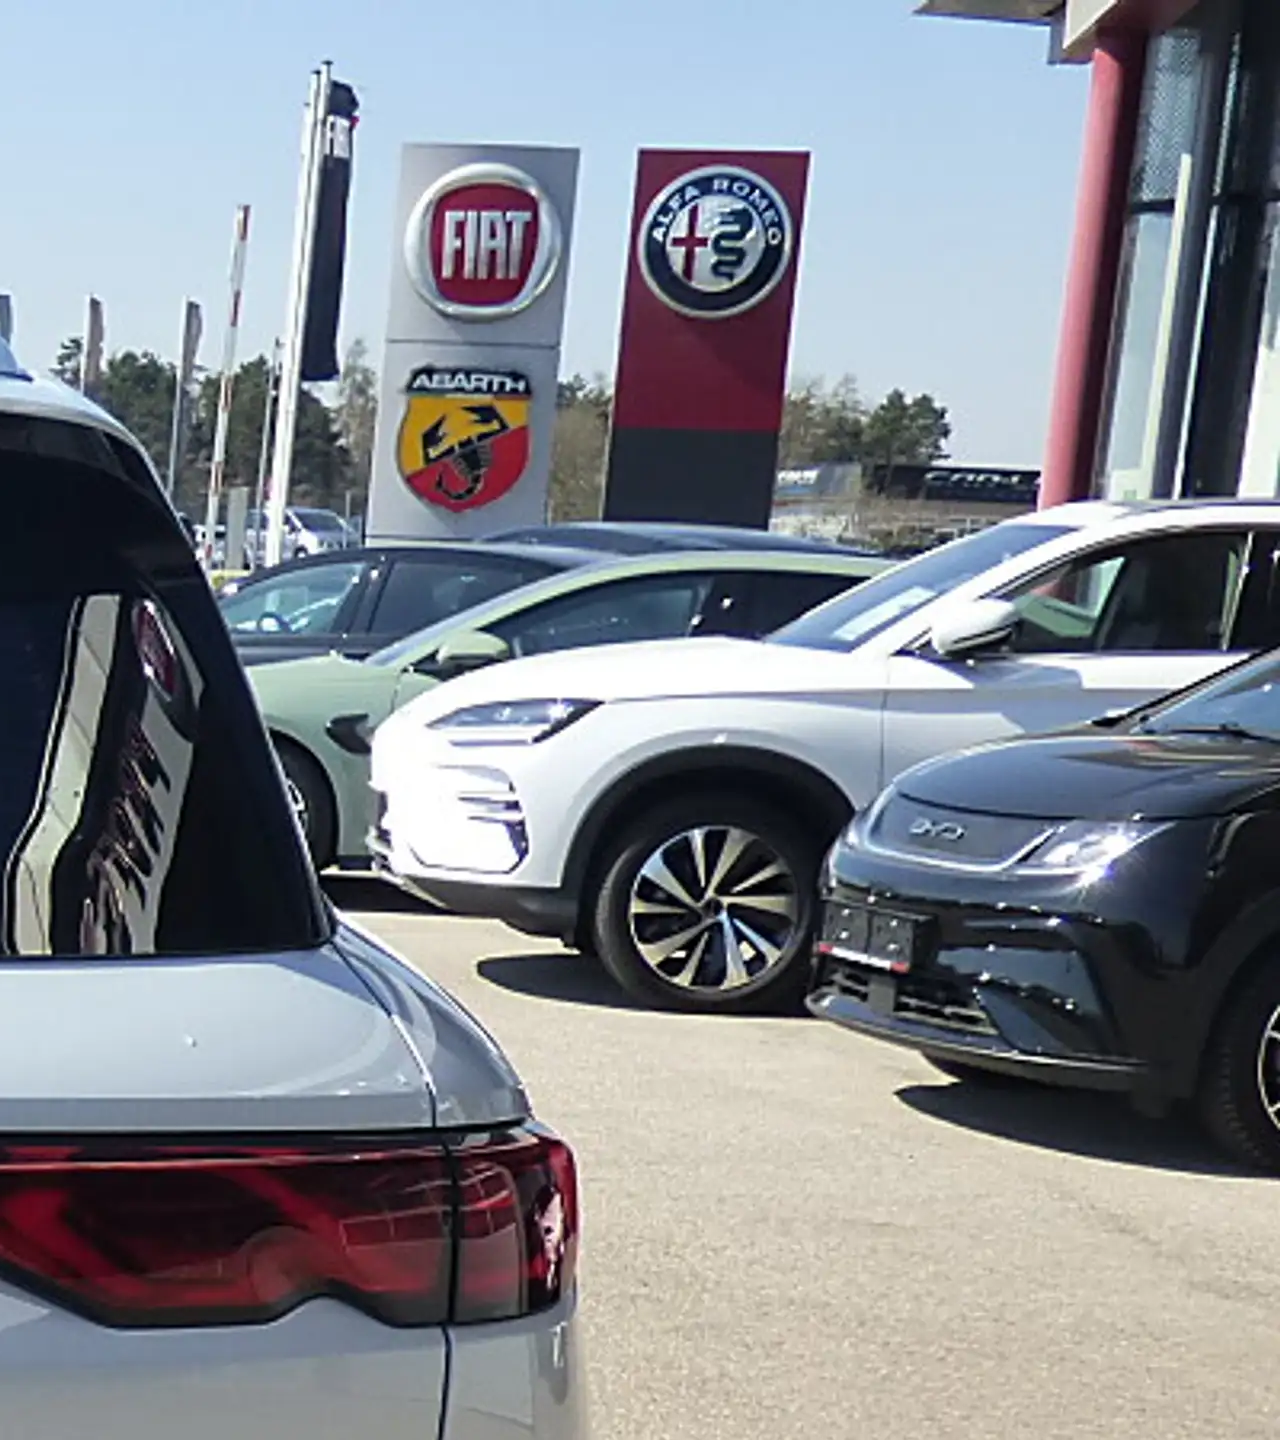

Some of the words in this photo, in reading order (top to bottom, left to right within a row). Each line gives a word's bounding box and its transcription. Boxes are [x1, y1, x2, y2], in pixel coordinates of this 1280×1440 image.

[442, 210, 532, 280] FIAT
[652, 185, 701, 243] ALFA
[713, 178, 782, 245] ROMEO
[412, 372, 526, 393] ABARTH
